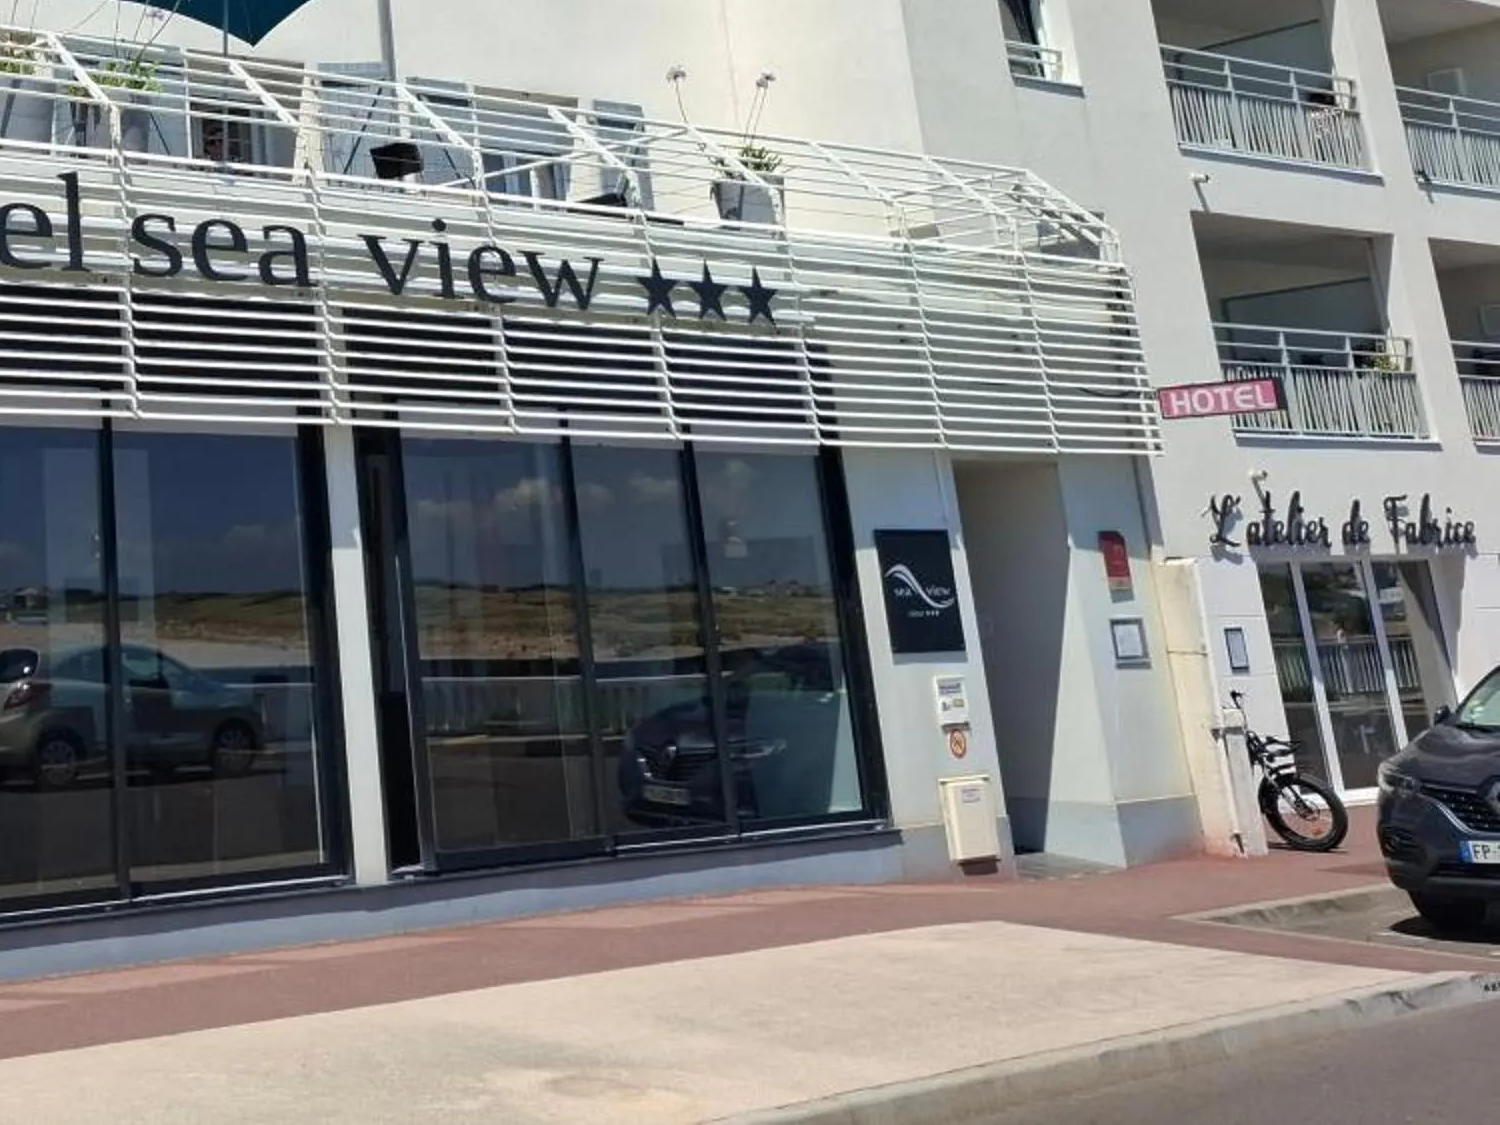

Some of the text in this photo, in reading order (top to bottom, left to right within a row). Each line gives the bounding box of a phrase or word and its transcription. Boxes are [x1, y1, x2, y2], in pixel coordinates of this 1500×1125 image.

[132, 213, 317, 288] sea
[358, 218, 604, 311] view
[1169, 384, 1277, 415] HOTEL
[1342, 499, 1371, 545] de
[1383, 493, 1476, 548] Fabrice
